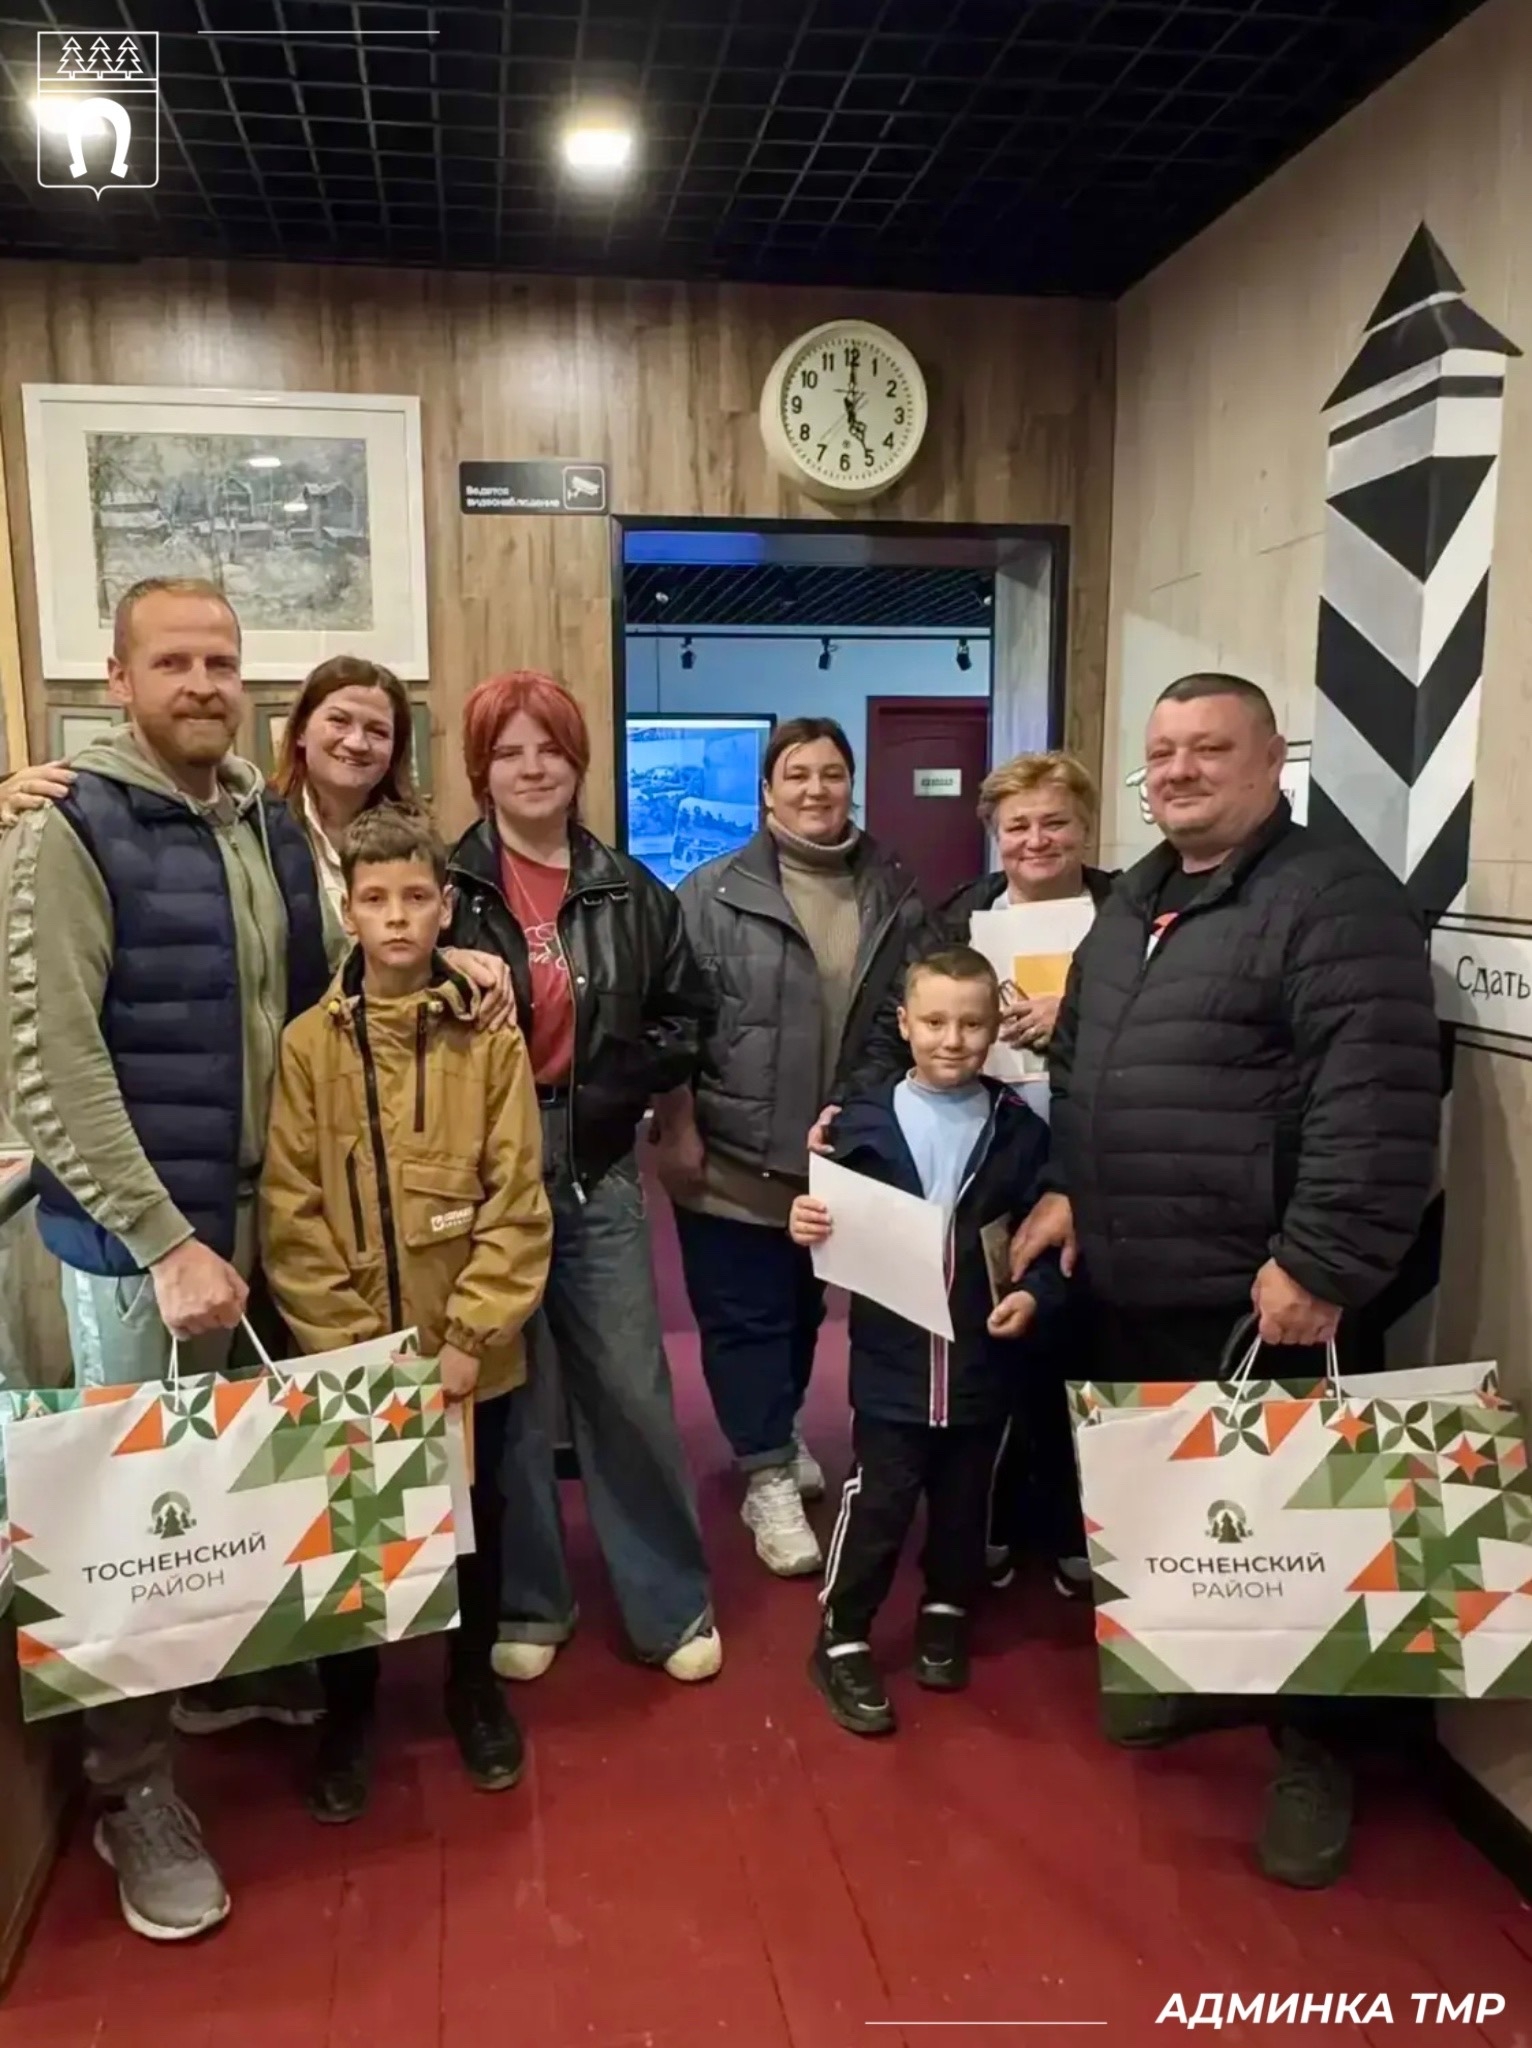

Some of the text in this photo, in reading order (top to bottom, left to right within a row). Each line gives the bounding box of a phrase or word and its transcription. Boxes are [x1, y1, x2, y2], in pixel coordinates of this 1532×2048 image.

[822, 353, 835, 372] 11
[844, 348, 860, 367] 12
[871, 358, 878, 377] 1
[801, 370, 818, 389] 10
[886, 380, 897, 398] 2
[791, 396, 802, 414] 9
[894, 407, 905, 424] 3
[800, 424, 810, 441] 8
[883, 432, 894, 450] 4
[817, 444, 828, 462] 7
[840, 454, 850, 471] 6
[864, 449, 875, 467] 5
[1456, 955, 1531, 1001] Сдать
[82, 1531, 267, 1584] ТОСНЕНСКИЙ
[1145, 1552, 1326, 1574] ТОСНЕНСКИЙ
[131, 1568, 225, 1604] РАЙОН
[1192, 1579, 1284, 1599] РАЙОН
